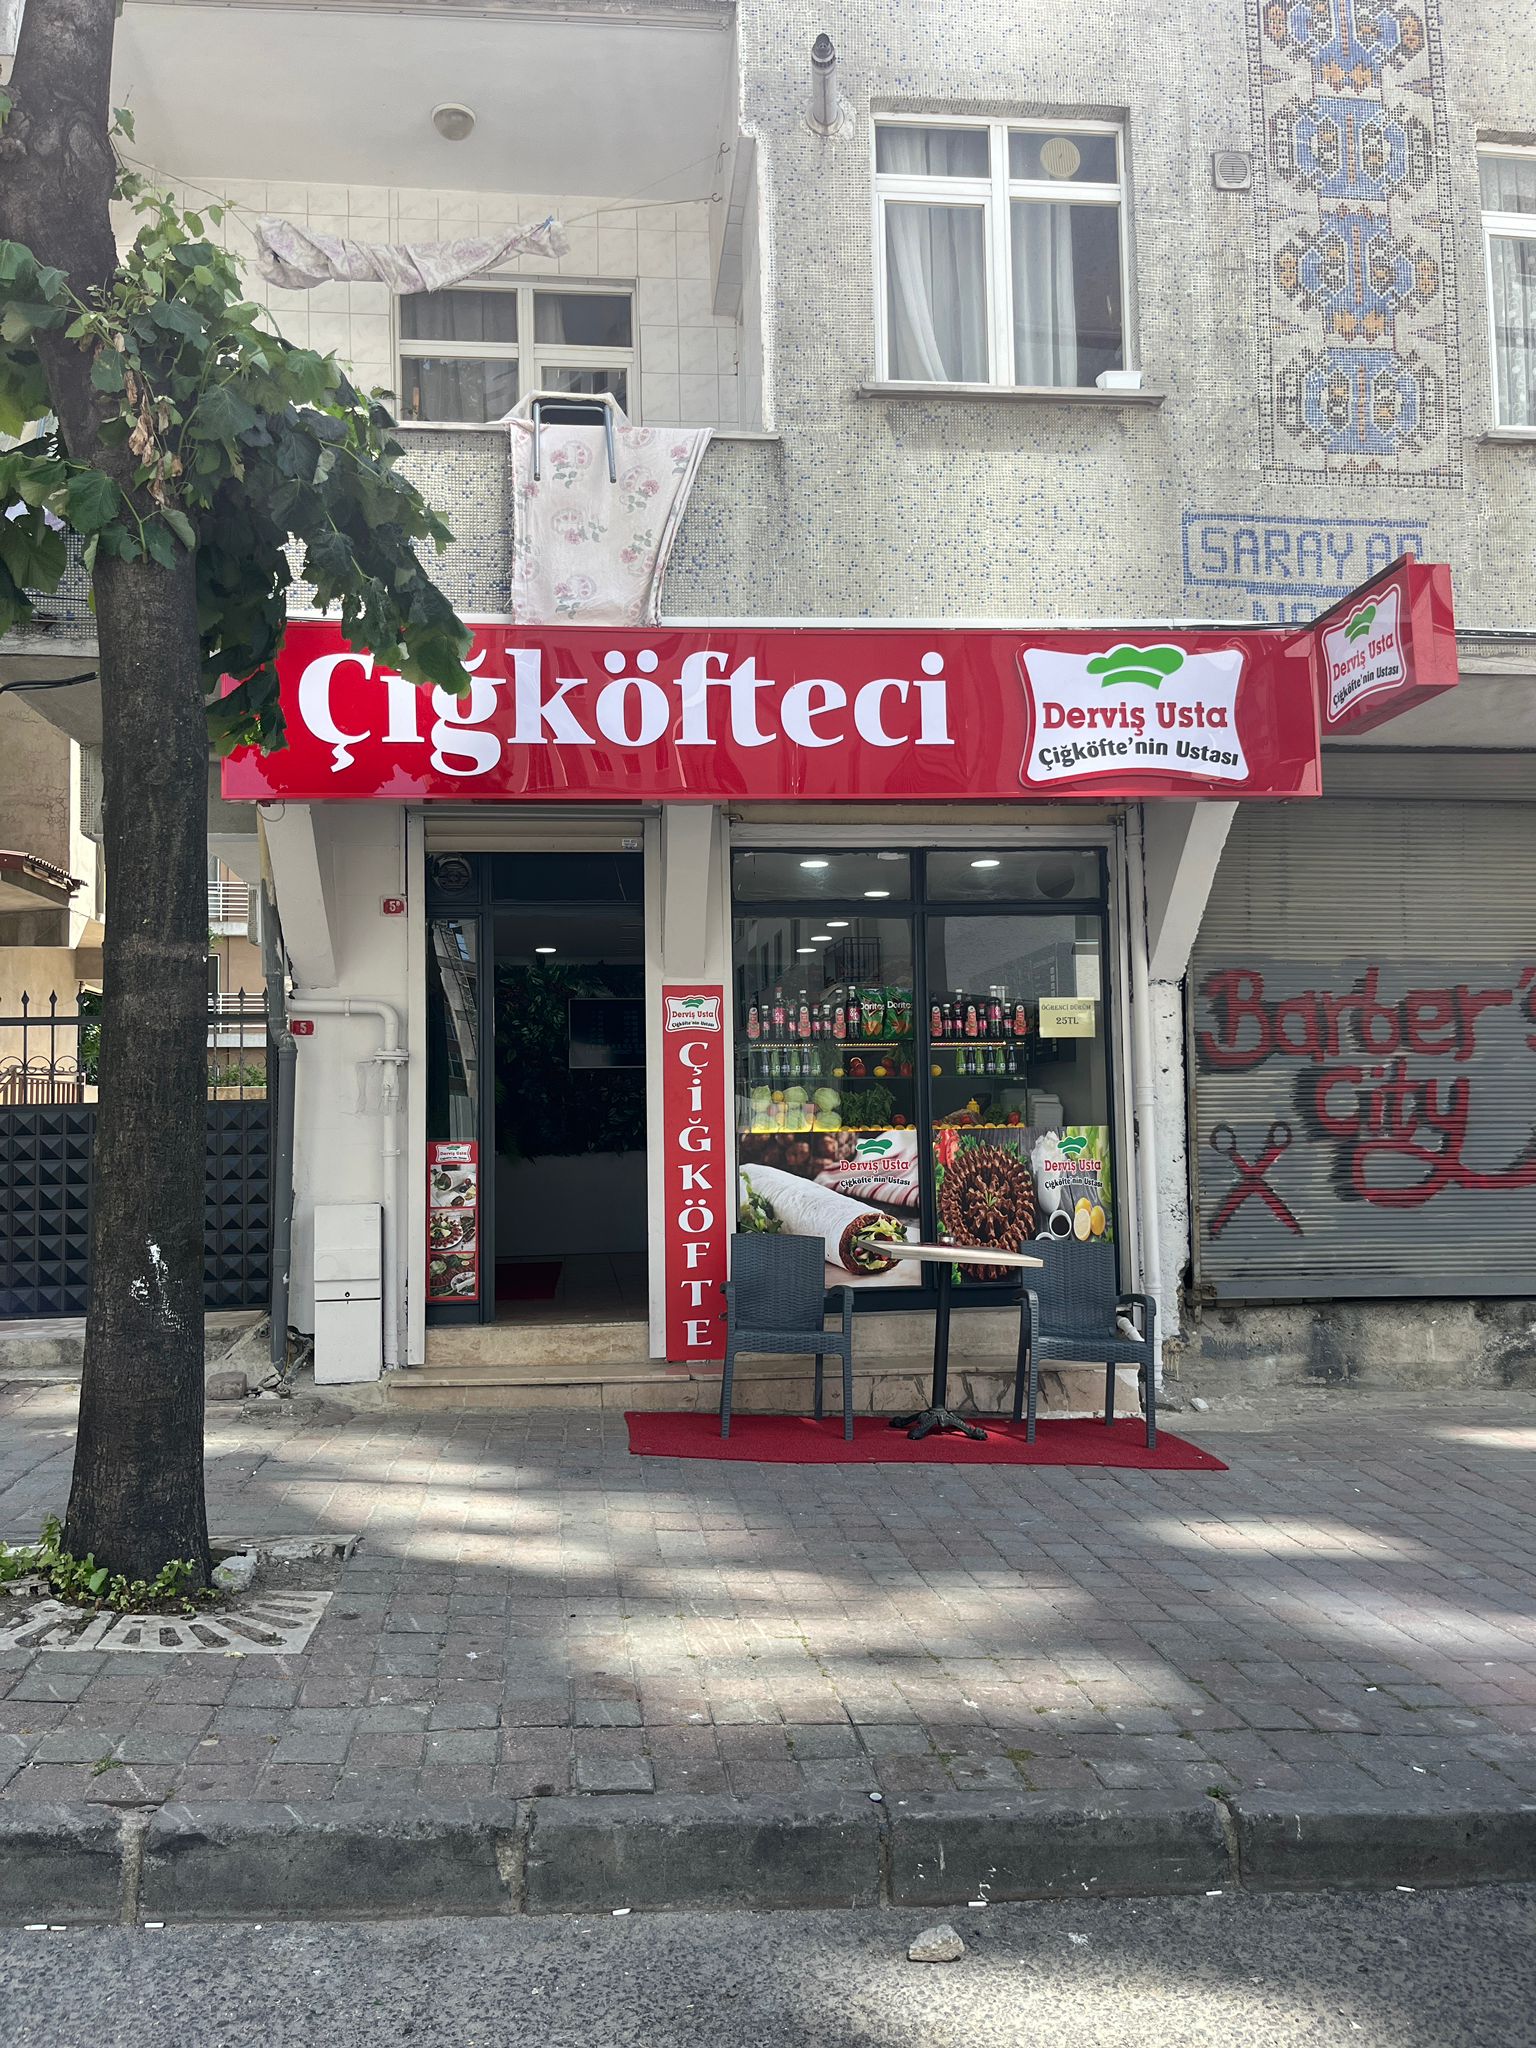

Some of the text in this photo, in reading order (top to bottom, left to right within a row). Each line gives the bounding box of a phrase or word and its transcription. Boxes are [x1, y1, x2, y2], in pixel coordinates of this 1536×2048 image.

[1200, 527, 1353, 579] SARAY
[1333, 633, 1394, 681] Derviş Usta
[1376, 665, 1399, 679] Ustası
[298, 648, 955, 776] Çiğköfteci
[1042, 702, 1227, 736] Derviş Usta
[1176, 740, 1239, 766] Ustası
[300, 1022, 307, 1034] 5
[1056, 1016, 1079, 1025] 25TL
[840, 1159, 909, 1174] Derviş Usta
[1044, 1159, 1101, 1174] Derviş Usta
[888, 1176, 911, 1186] Ustası
[1084, 1177, 1103, 1188] Ustası
